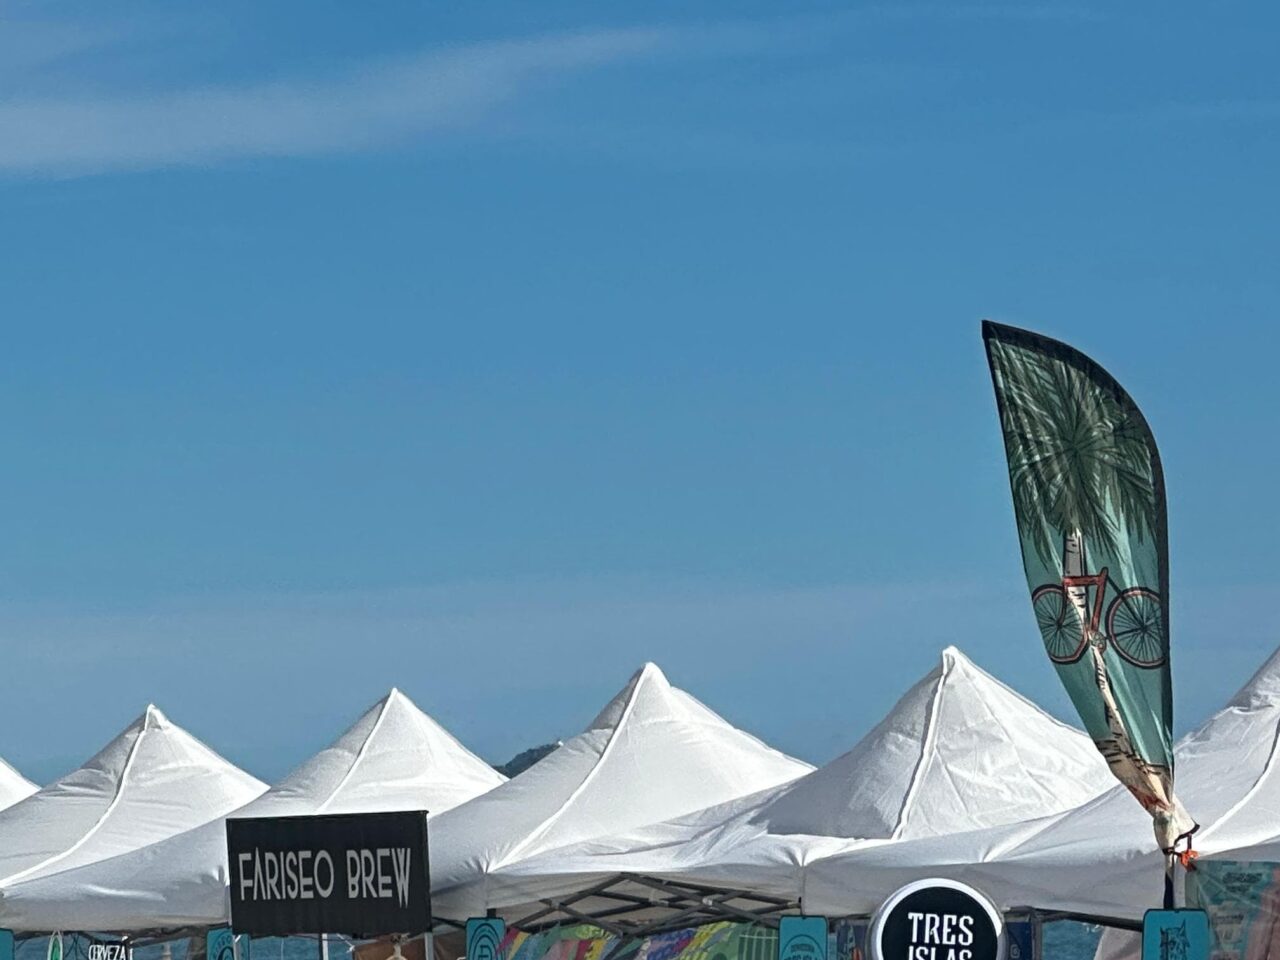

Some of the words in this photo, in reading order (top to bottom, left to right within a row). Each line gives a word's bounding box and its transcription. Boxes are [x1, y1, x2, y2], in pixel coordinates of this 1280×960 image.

[238, 846, 334, 901] FARISEO
[346, 847, 411, 909] BREW
[908, 911, 974, 946] TRES
